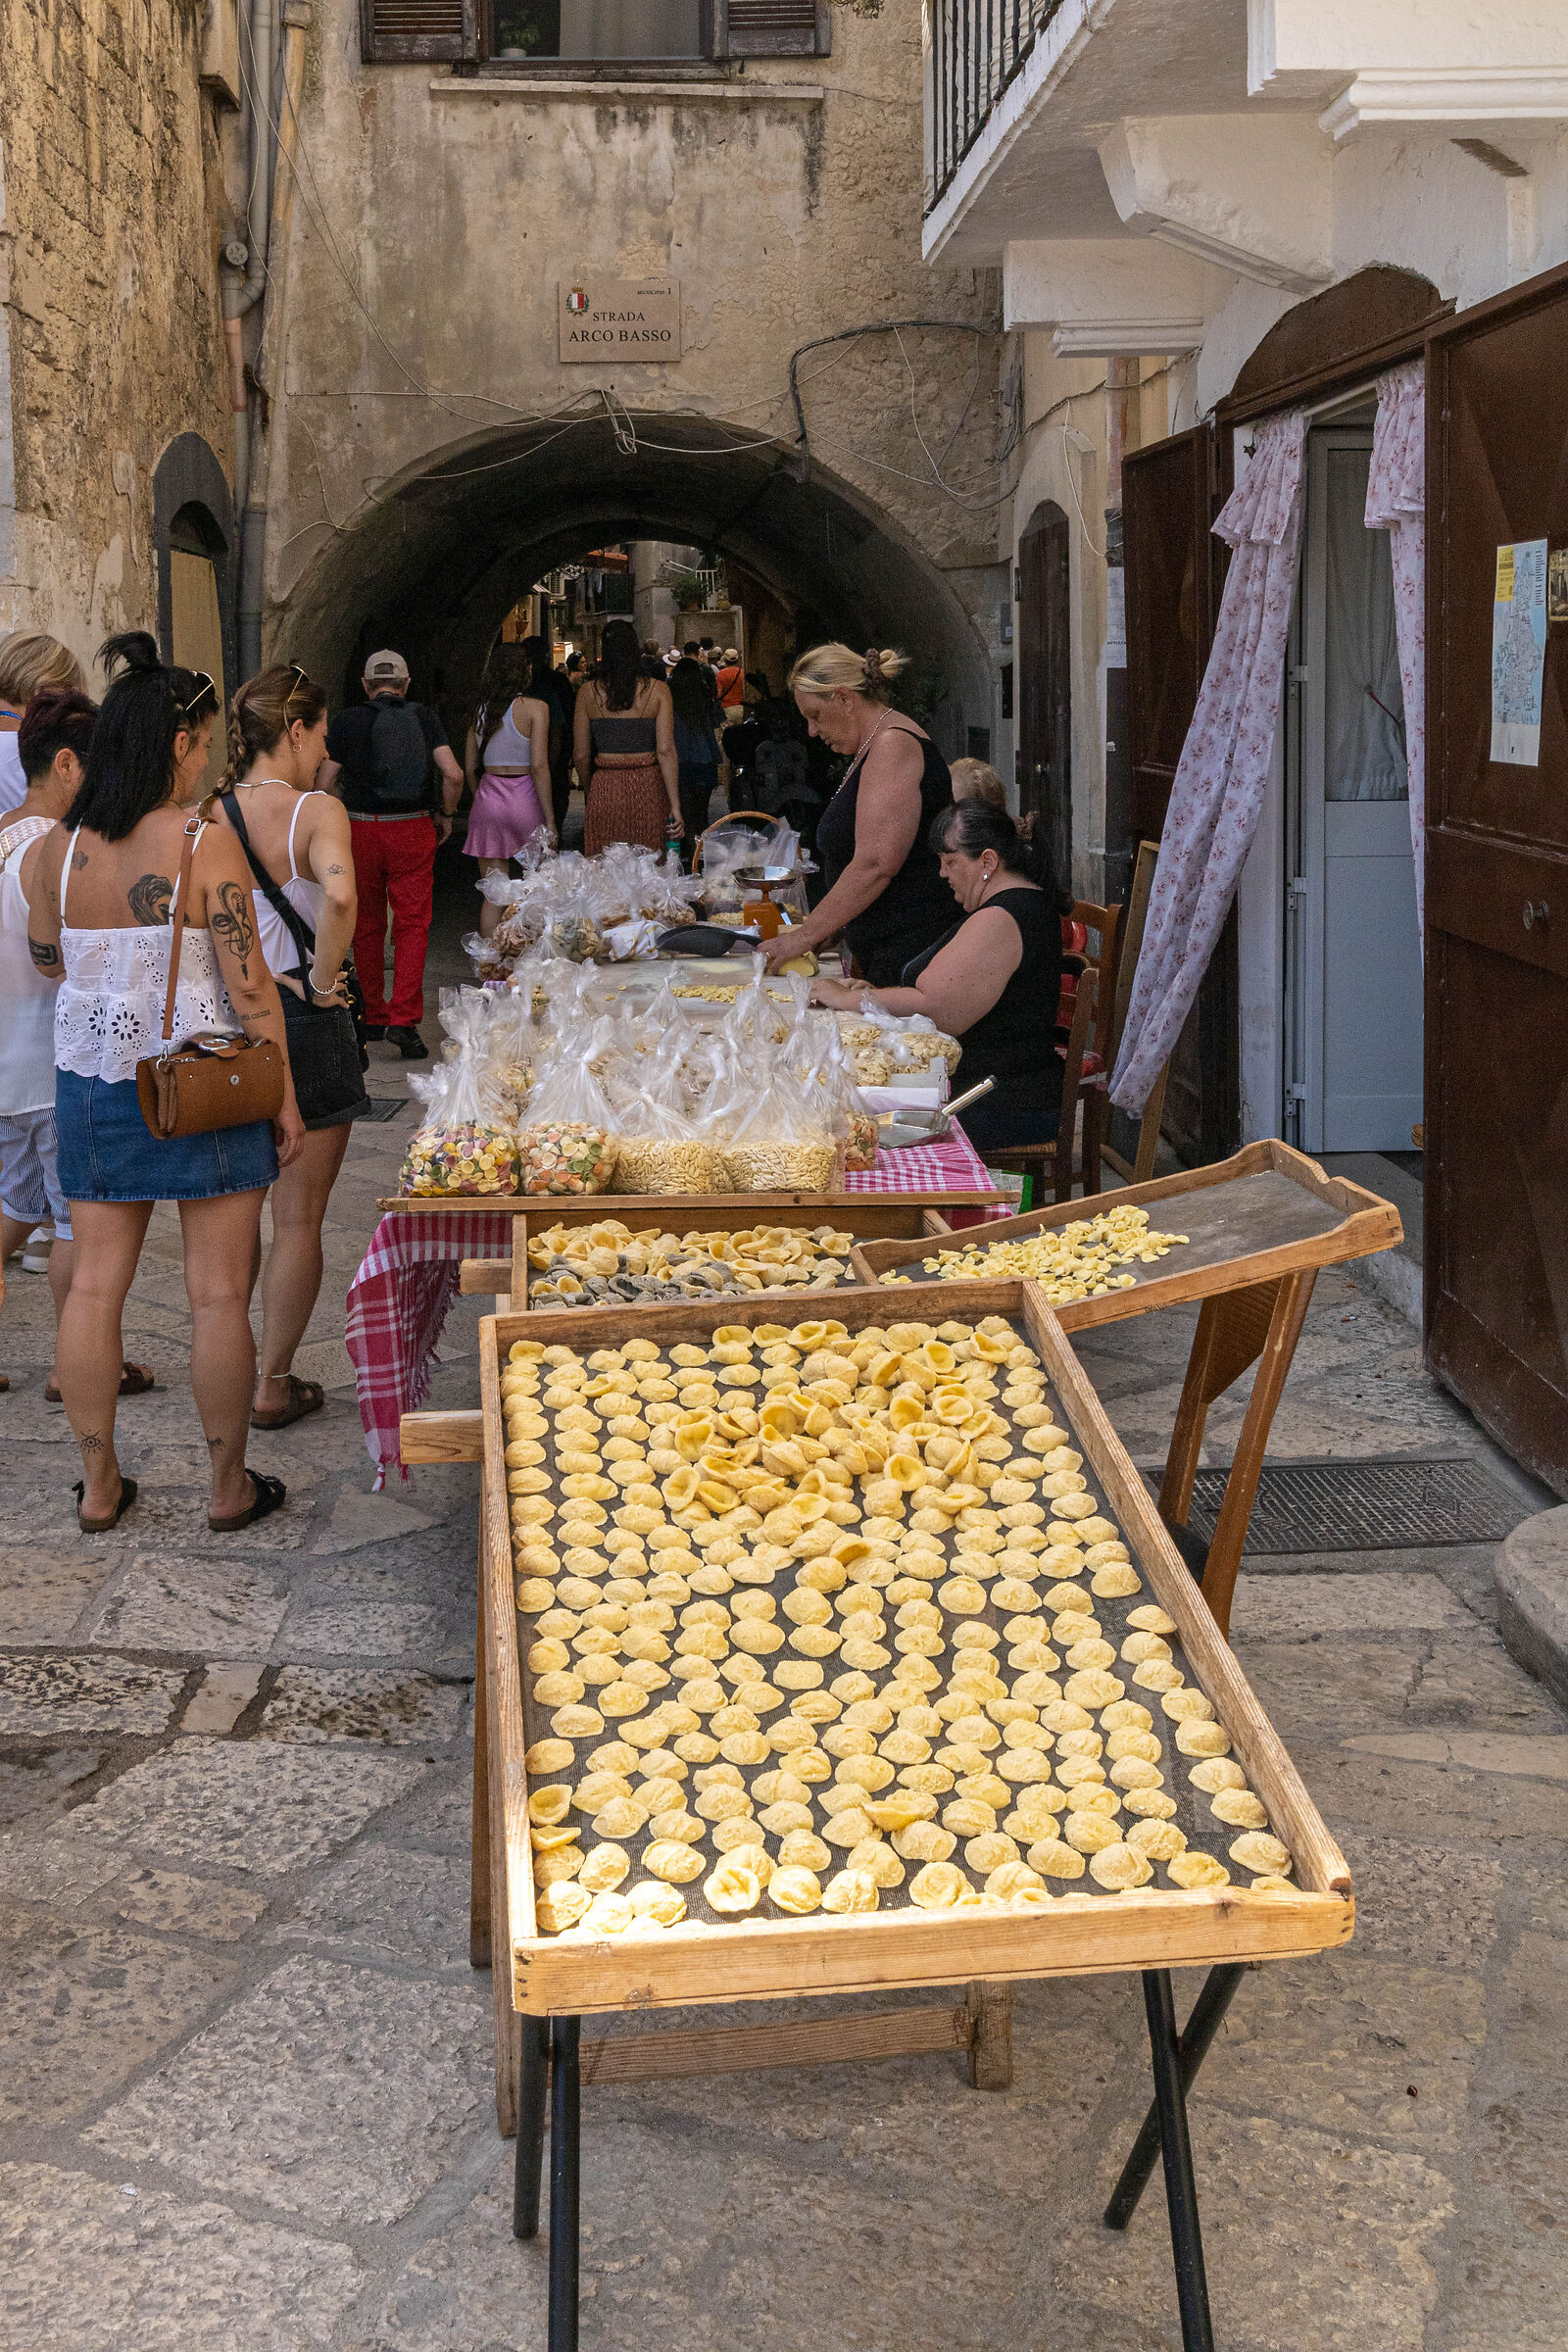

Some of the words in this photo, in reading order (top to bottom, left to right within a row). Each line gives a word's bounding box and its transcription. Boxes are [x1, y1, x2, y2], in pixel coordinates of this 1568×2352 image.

[593, 312, 646, 321] STRADA
[568, 329, 613, 342] ARCO
[619, 329, 671, 342] BASSO
